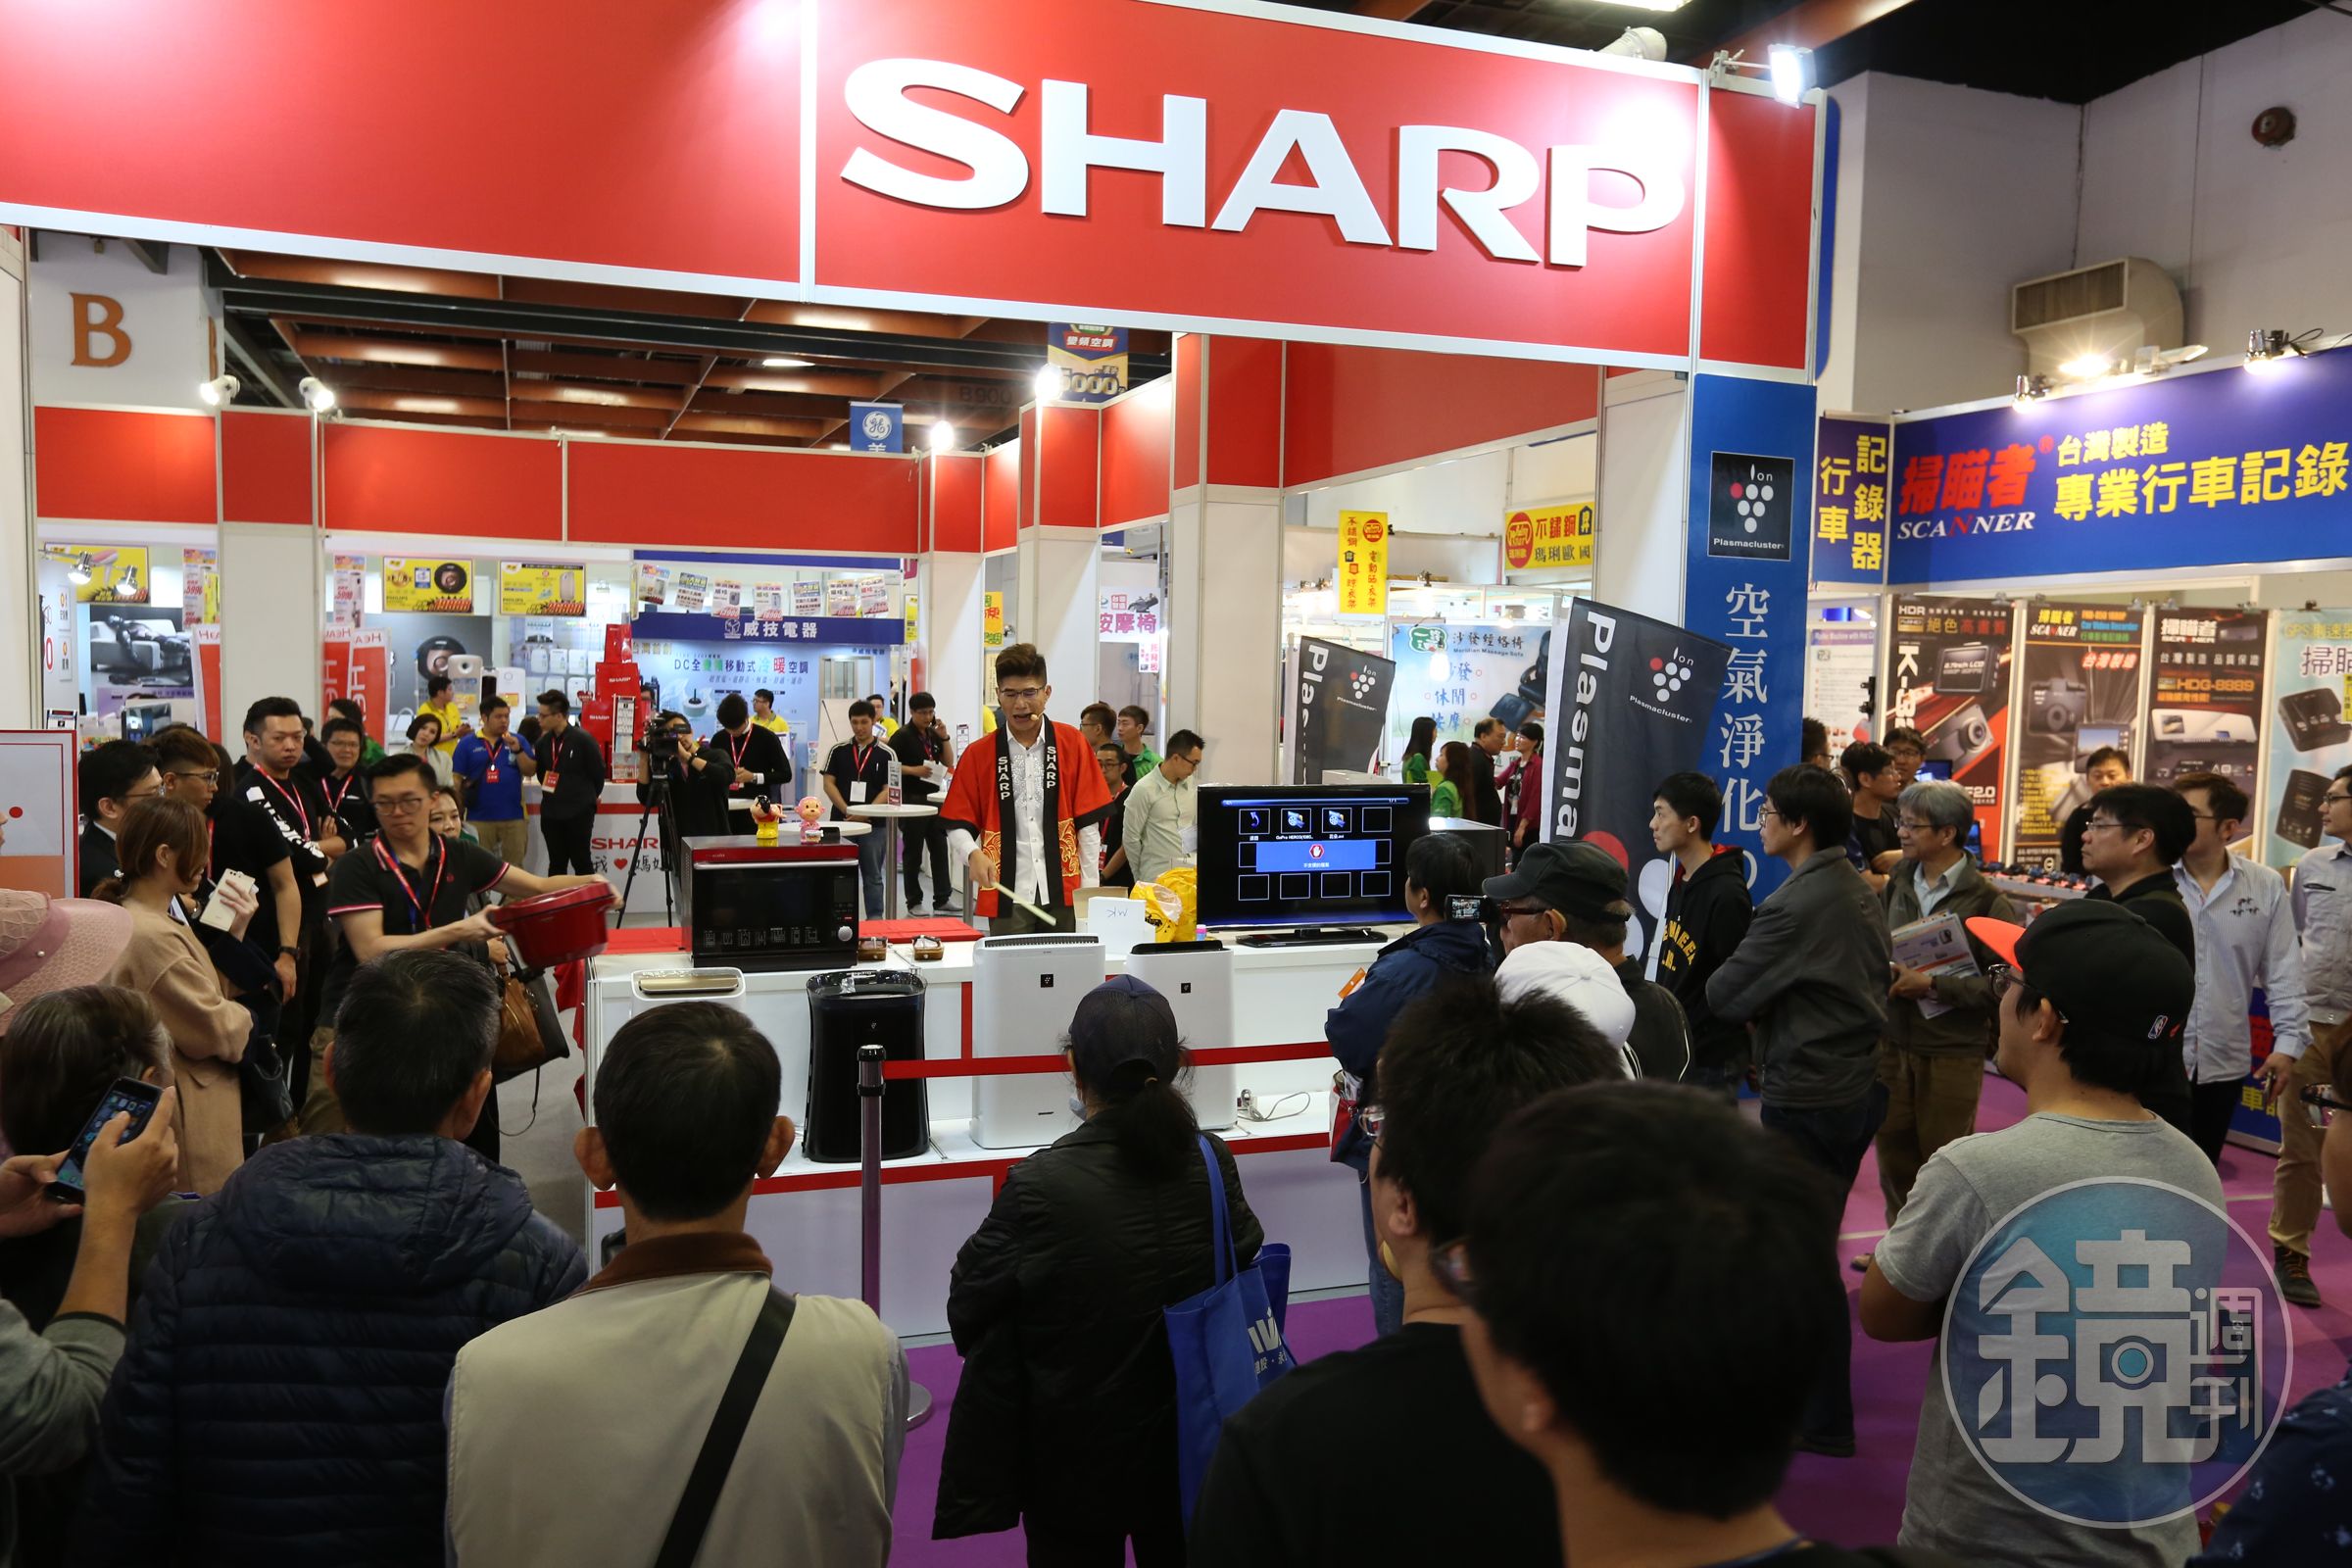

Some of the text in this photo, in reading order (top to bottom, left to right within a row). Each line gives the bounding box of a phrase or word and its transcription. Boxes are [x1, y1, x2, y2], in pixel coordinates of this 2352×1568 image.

[841, 58, 1685, 268] SHARP
[69, 292, 132, 368] B
[2057, 421, 2169, 467] 台灣製造
[1750, 464, 1773, 481] Ion
[1898, 443, 2036, 516] 掃瞄者
[2054, 440, 2350, 522] 專業行車記錄
[1818, 457, 1851, 544] 行車
[1851, 434, 1887, 570] 記錄器
[1713, 538, 1782, 550] Plasmacluster
[1897, 511, 2036, 541] SCANNER
[744, 620, 818, 638] 威技電器
[1898, 606, 1926, 615] HDR
[2030, 624, 2078, 637] SCANNER
[1673, 647, 1694, 666] Ion
[1337, 696, 1376, 711] Plasmacluster
[1555, 611, 1616, 838] Plasma
[1630, 695, 1690, 723] Plasmacluster
[998, 757, 1010, 800] SHARP
[1047, 746, 1057, 789] SHARP
